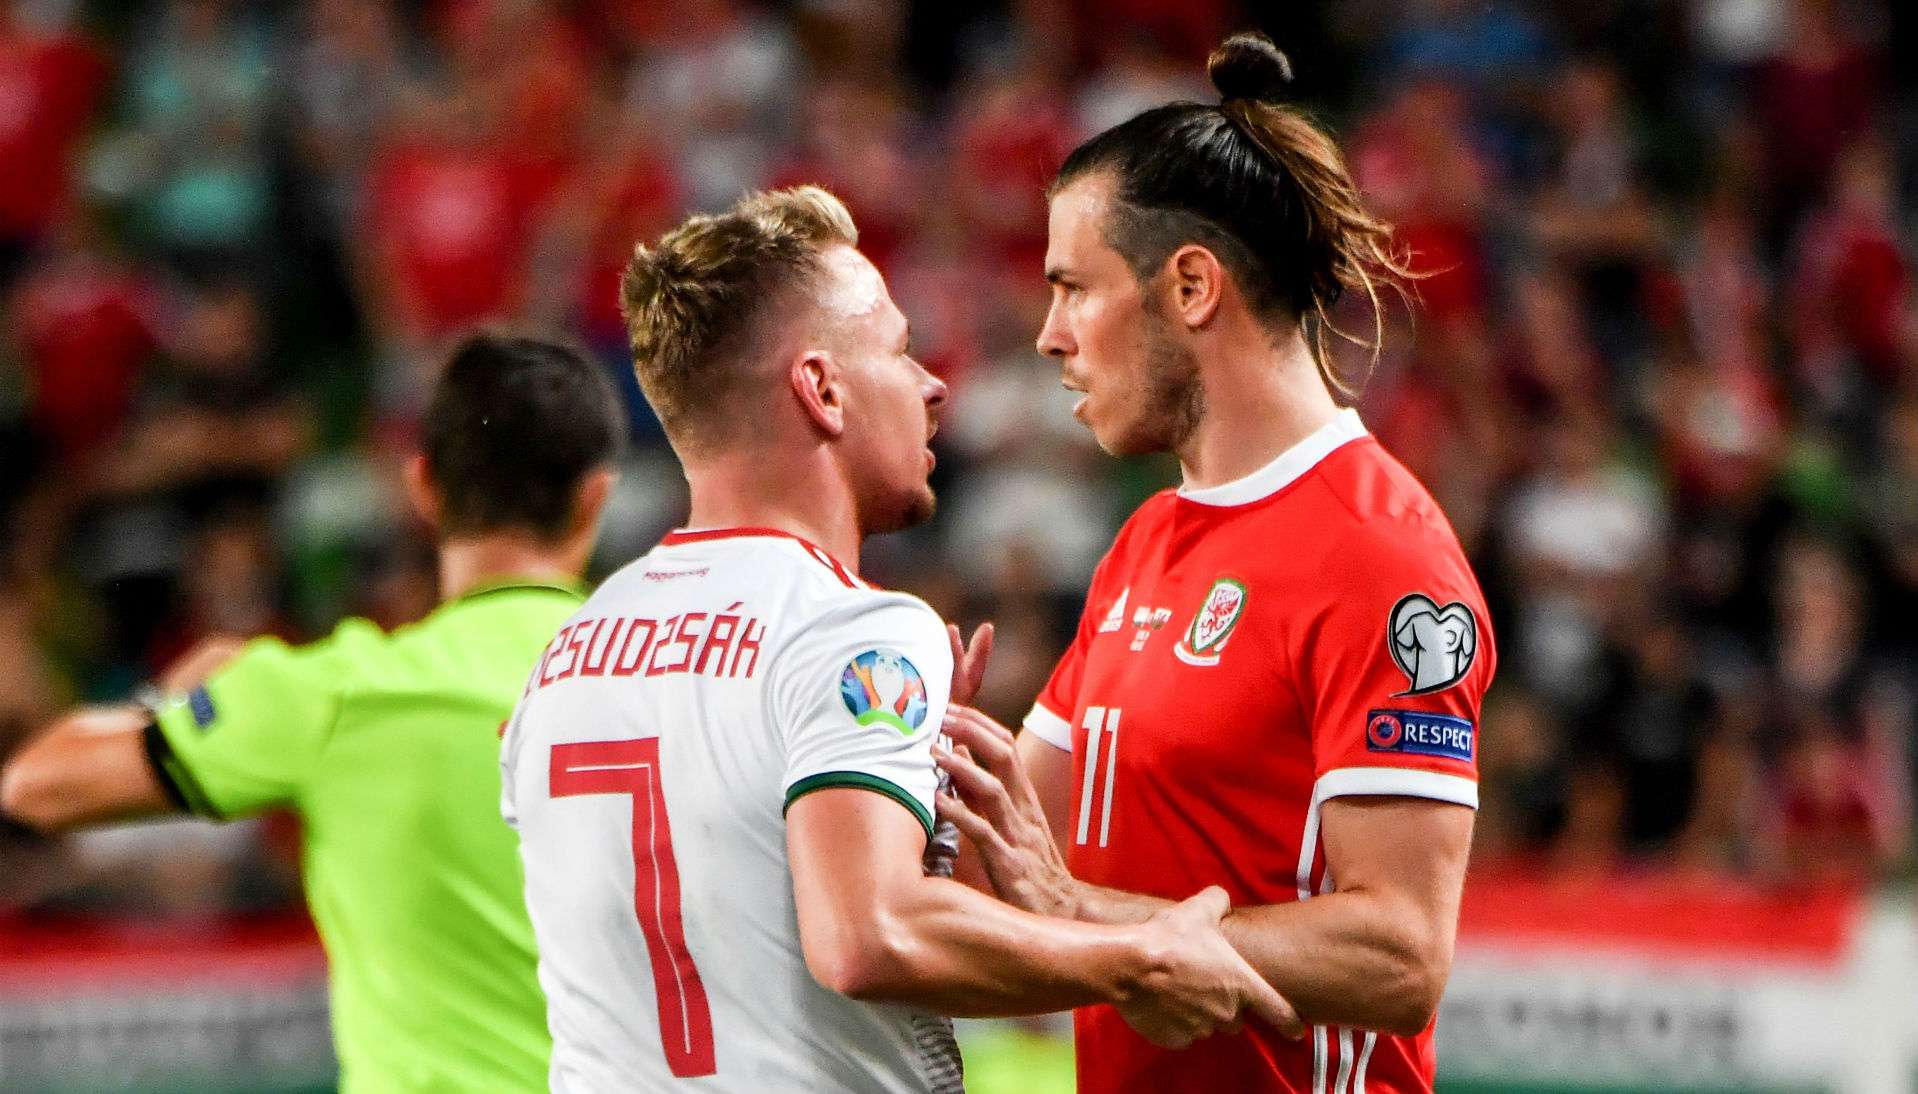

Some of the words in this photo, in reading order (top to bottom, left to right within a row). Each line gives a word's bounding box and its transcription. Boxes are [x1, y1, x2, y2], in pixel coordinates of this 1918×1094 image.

[523, 602, 766, 697] ZSUDZSÁK
[1076, 706, 1121, 848] 11
[1405, 723, 1472, 751] RESPECT
[549, 737, 717, 1077] 7
